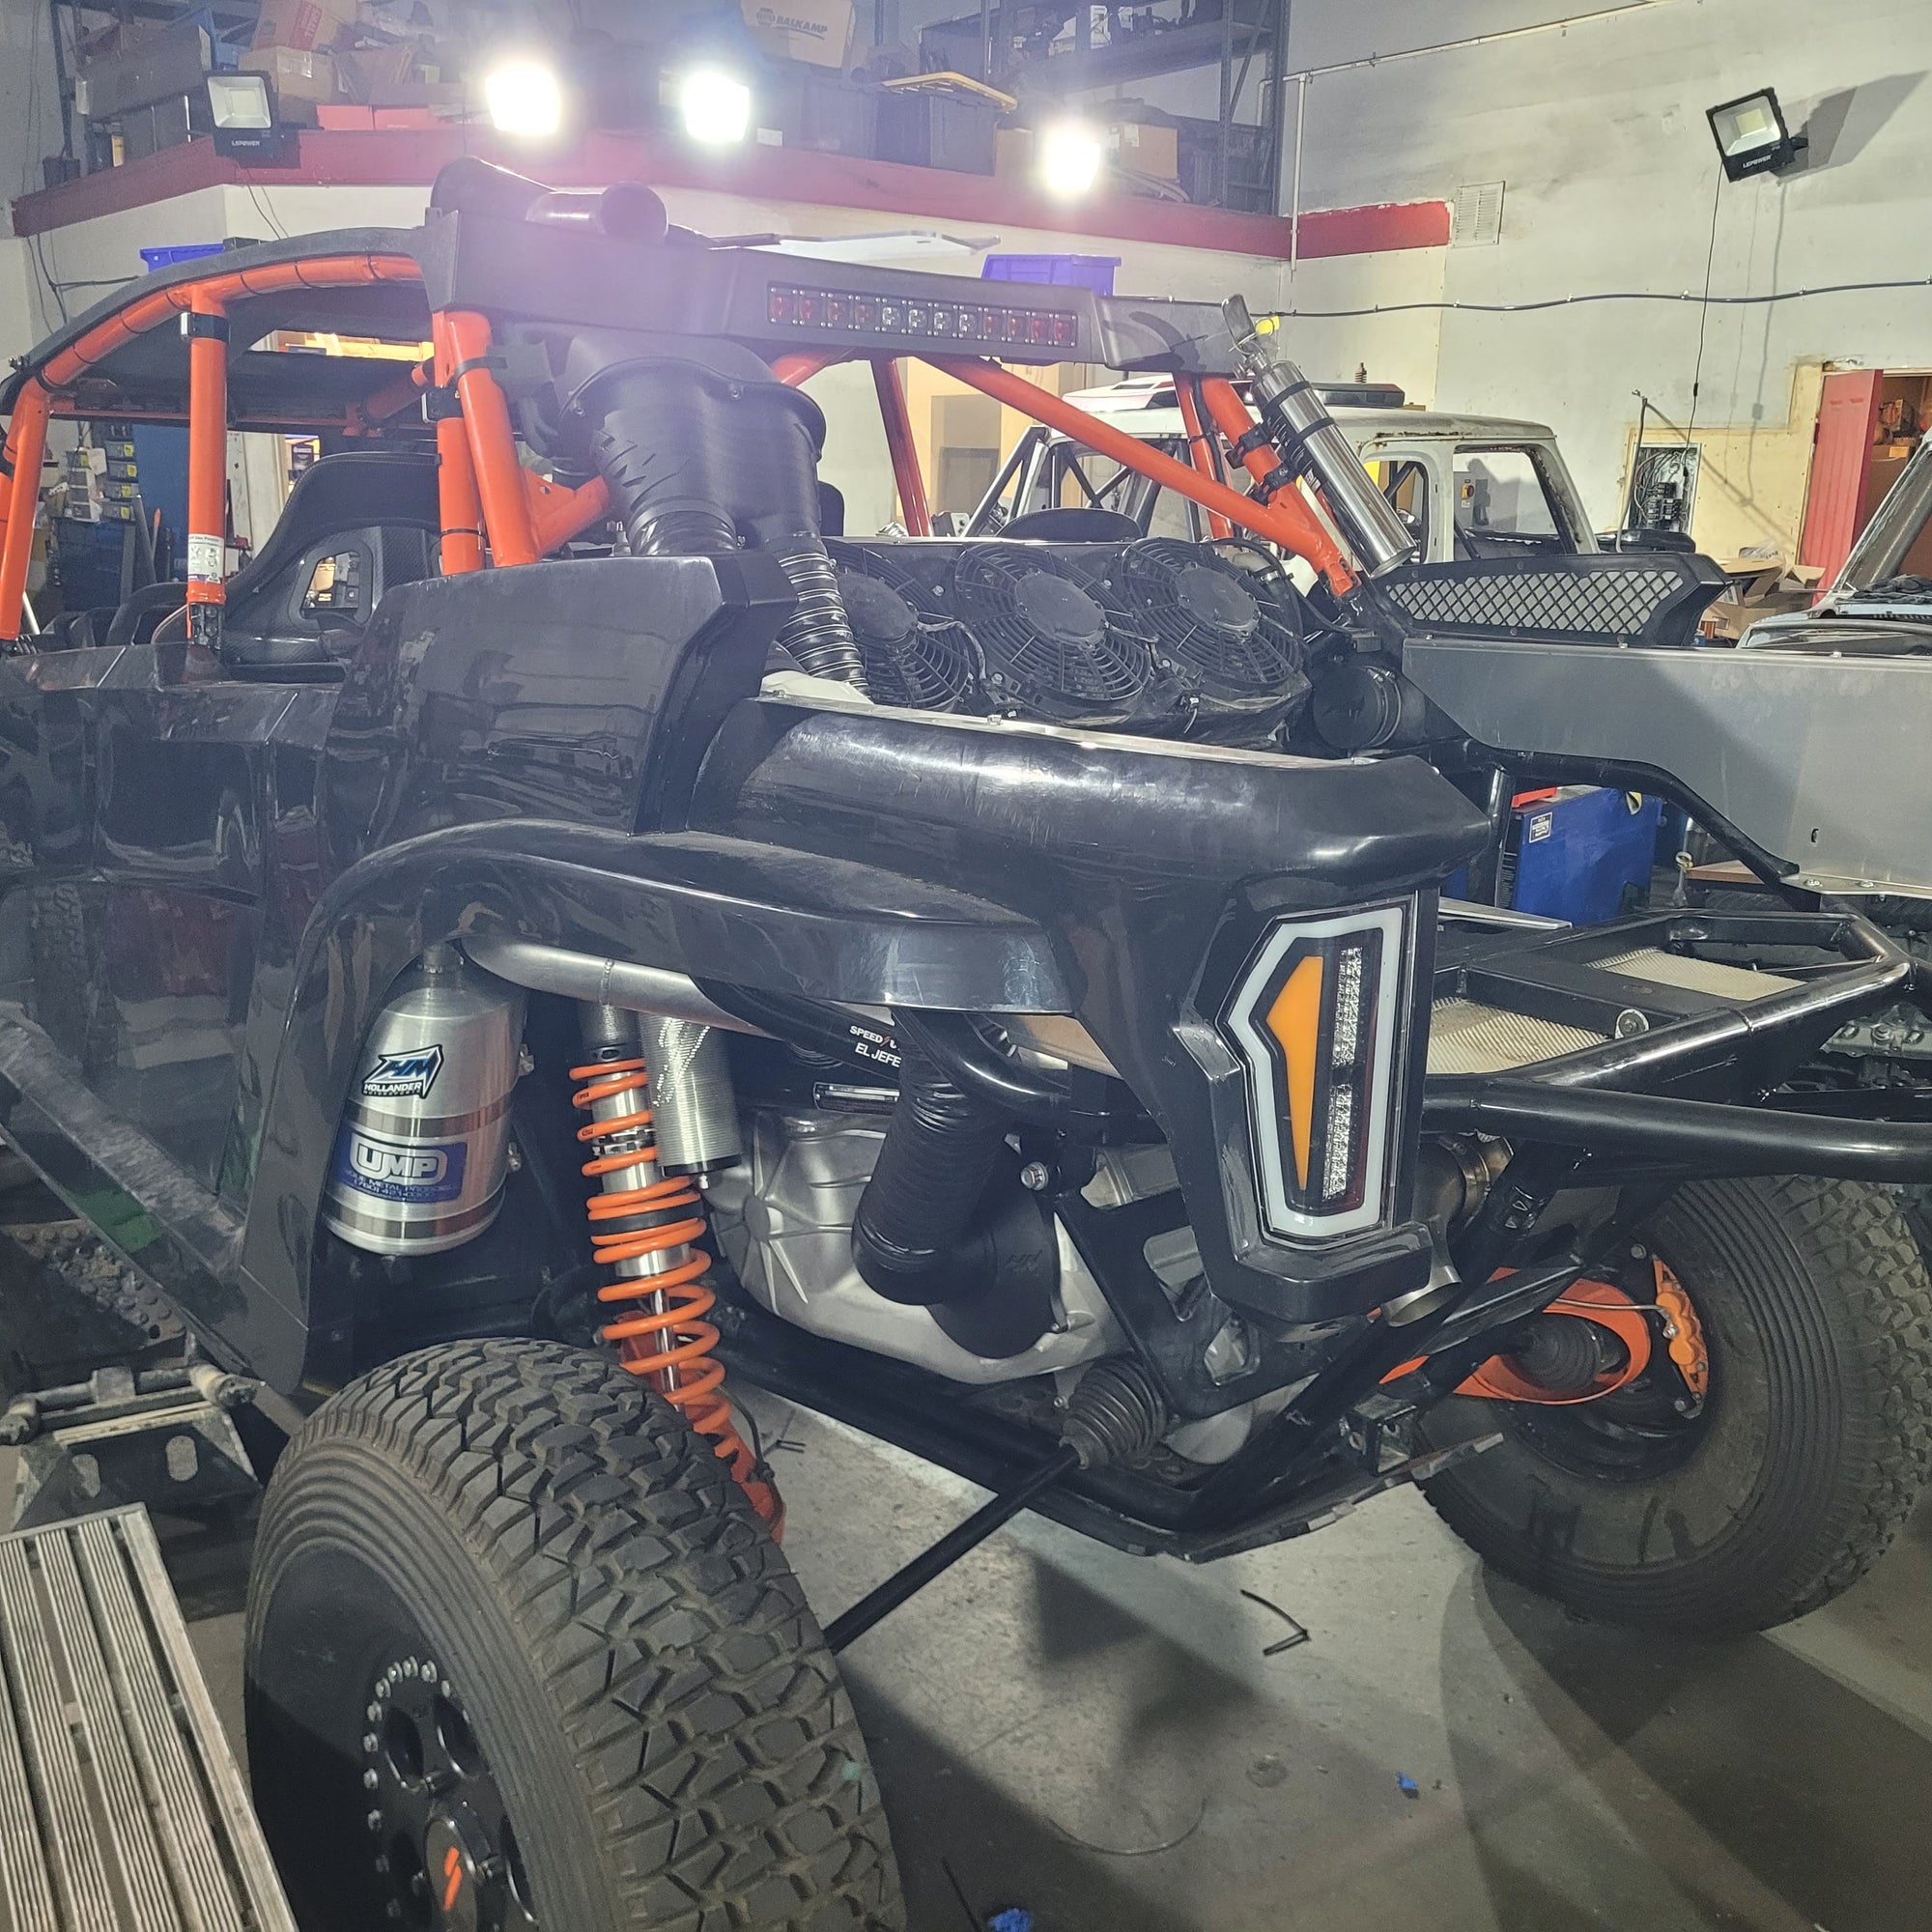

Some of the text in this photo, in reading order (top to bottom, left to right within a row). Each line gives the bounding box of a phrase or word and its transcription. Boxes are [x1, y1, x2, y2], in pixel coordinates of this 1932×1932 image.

[776, 14, 828, 33] BALKAMP
[850, 1026, 883, 1043] SPEED
[855, 1041, 902, 1068] EL JEFE
[364, 1082, 422, 1094] HOLLANDER
[357, 1144, 439, 1178] UMP
[368, 1179, 401, 1192] METAL
